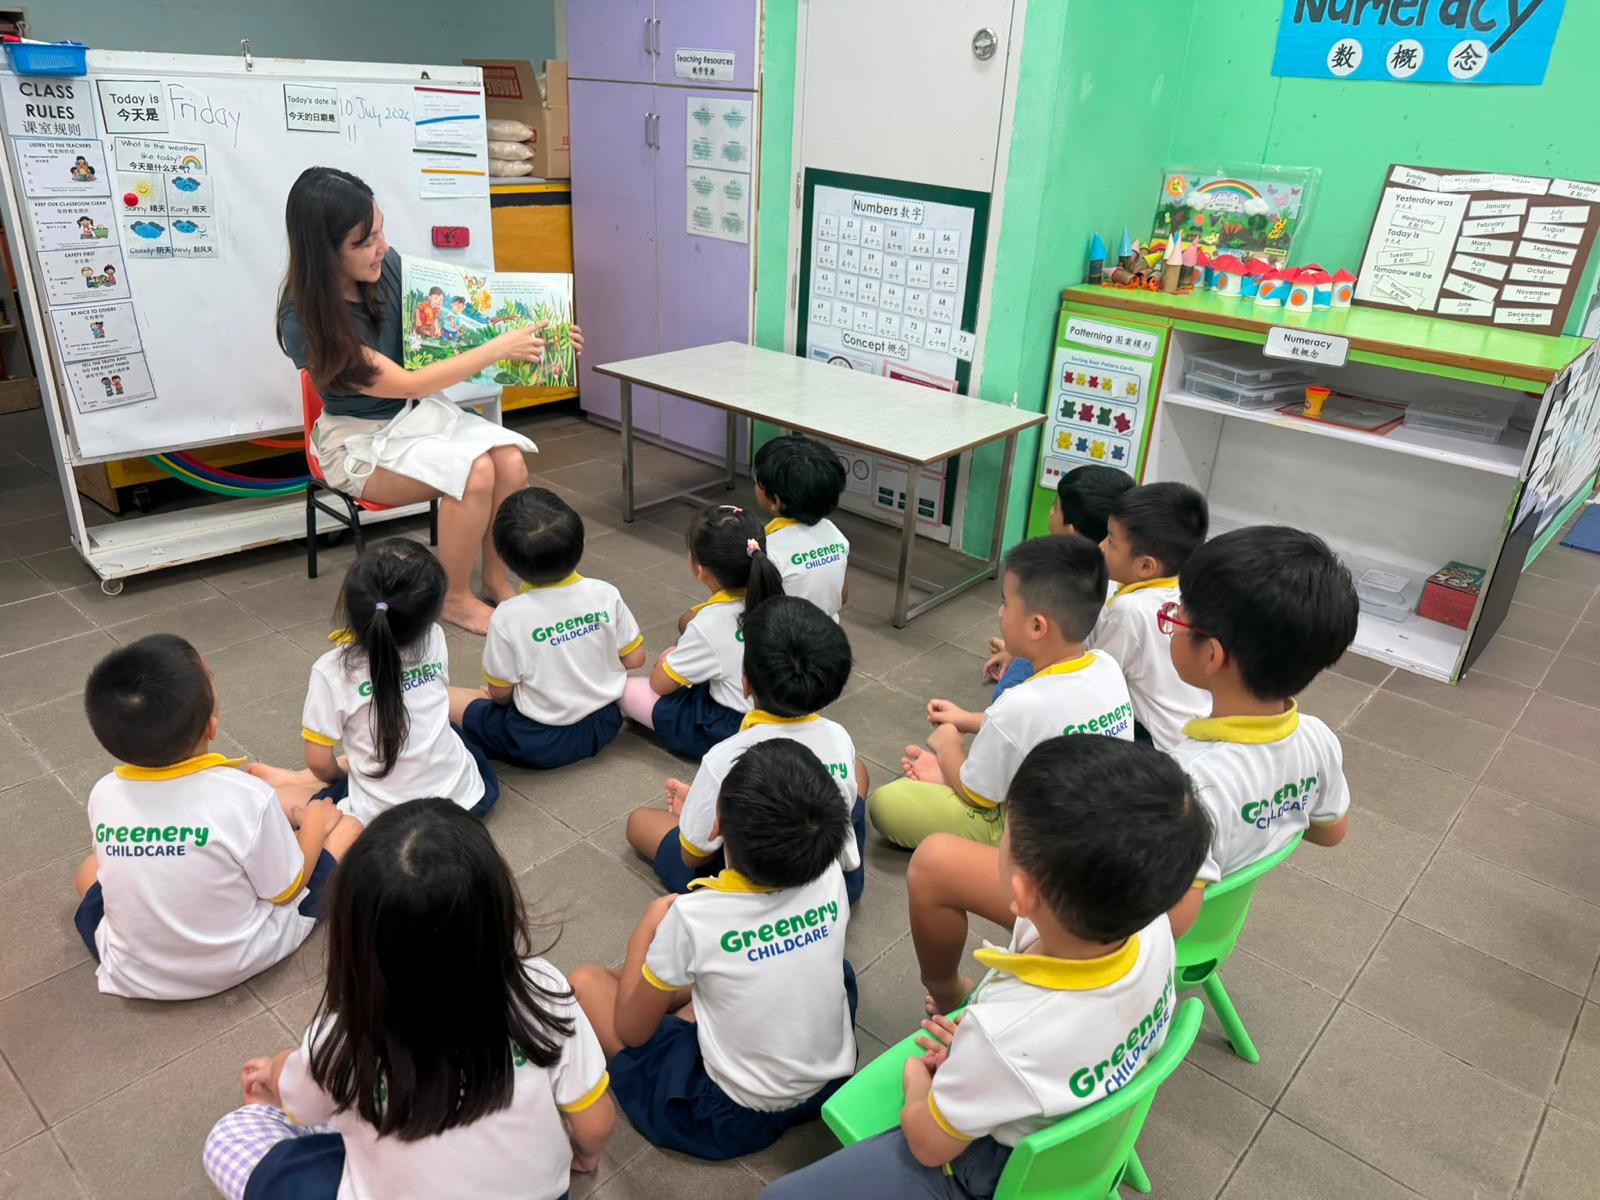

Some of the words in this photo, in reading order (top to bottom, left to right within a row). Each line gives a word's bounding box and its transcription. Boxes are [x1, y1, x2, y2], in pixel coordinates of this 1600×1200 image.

[676, 54, 702, 65] Teaching
[703, 56, 733, 66] Resources
[19, 82, 75, 99] CLASS
[109, 93, 145, 107] Today
[150, 94, 160, 104] is
[287, 95, 313, 106] Today's
[26, 104, 75, 120] RULES
[117, 108, 160, 122] 今天是
[167, 83, 240, 149] Friday
[288, 111, 336, 123] 今天的日期是
[340, 97, 353, 117] 10
[356, 96, 381, 128] July
[23, 120, 81, 136] 课室规则
[120, 140, 141, 148] What
[153, 142, 166, 150] the
[168, 144, 199, 153] weather
[141, 151, 154, 160] like
[157, 152, 181, 163] today?
[1405, 171, 1427, 182] Sunday
[1568, 182, 1598, 194] Saturday
[1395, 193, 1436, 206] Yesterday
[1438, 199, 1454, 207] was
[124, 205, 147, 214] Sunny
[192, 205, 207, 213] 雨天
[853, 199, 898, 216] Numbers
[900, 205, 922, 220] 数字
[1550, 208, 1565, 216] July
[847, 220, 854, 228] 52
[1401, 214, 1435, 226] Wednesday
[1387, 228, 1412, 239] Today
[1413, 231, 1420, 239] is
[1542, 225, 1566, 233] August
[918, 232, 926, 240] 55
[943, 234, 950, 242] 56
[1471, 239, 1492, 247] March
[129, 247, 154, 256] Cloudy
[1532, 244, 1569, 256] September
[868, 253, 875, 261] 59
[1472, 259, 1487, 268] April
[890, 260, 898, 268] 60
[942, 267, 950, 275] 62
[1373, 265, 1408, 276] Tomorrow
[1409, 270, 1421, 278] will
[1526, 267, 1555, 275] October
[865, 282, 872, 290] 65
[1390, 282, 1412, 298] Thursday
[1462, 281, 1476, 291] May
[1515, 288, 1551, 297] November
[938, 298, 946, 306] 68
[861, 311, 868, 319] 71
[910, 322, 918, 330] 73
[959, 335, 967, 343] 75
[1069, 325, 1113, 344] Patterning
[843, 333, 885, 352] Concept
[1283, 333, 1333, 350] Numeracy
[887, 342, 907, 357] 概念
[1291, 346, 1320, 359] 数概念
[790, 543, 845, 566] Greenery
[805, 553, 841, 570] CHILDCARE
[531, 610, 610, 642] Greenery
[550, 623, 601, 646] CHILDCARE
[358, 661, 442, 697] Genery
[401, 673, 436, 693] DCARE
[1104, 719, 1128, 737] DCARE
[95, 822, 209, 848] Greenery
[105, 844, 186, 857] CHILDCARE
[720, 900, 838, 953] Greenery
[747, 925, 829, 962] CHILDCARE
[1068, 967, 1173, 1098] Greenery
[1104, 1007, 1170, 1096] CHILDCARE
